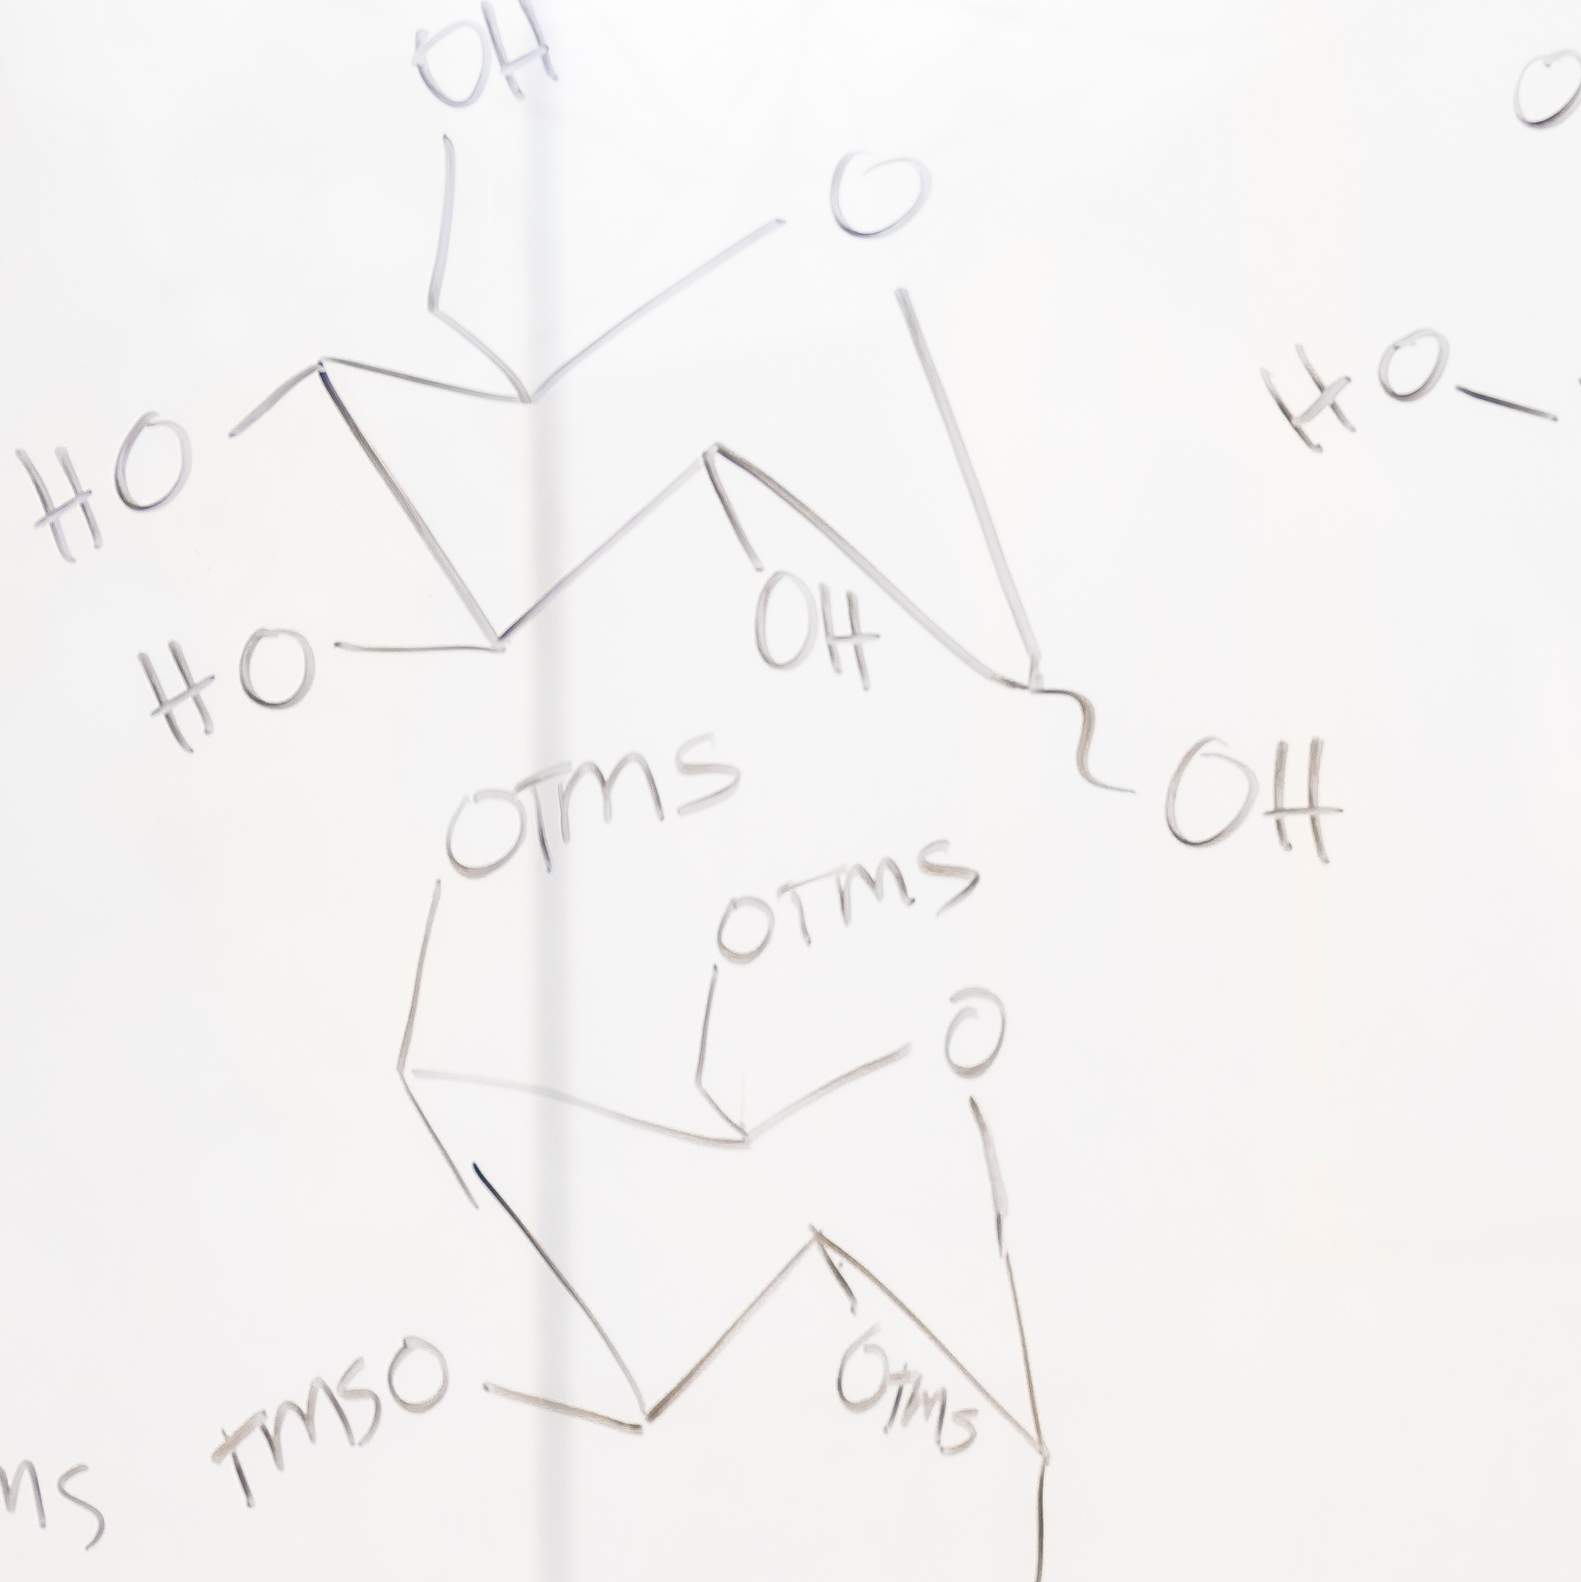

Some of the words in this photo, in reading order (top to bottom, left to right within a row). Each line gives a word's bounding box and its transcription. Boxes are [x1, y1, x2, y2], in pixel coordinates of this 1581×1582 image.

[413, 0, 558, 108] OH
[1261, 329, 1449, 453] HO
[15, 411, 192, 563] HO
[138, 627, 315, 754] HO
[755, 570, 881, 691] OH
[1165, 736, 1344, 864] OH
